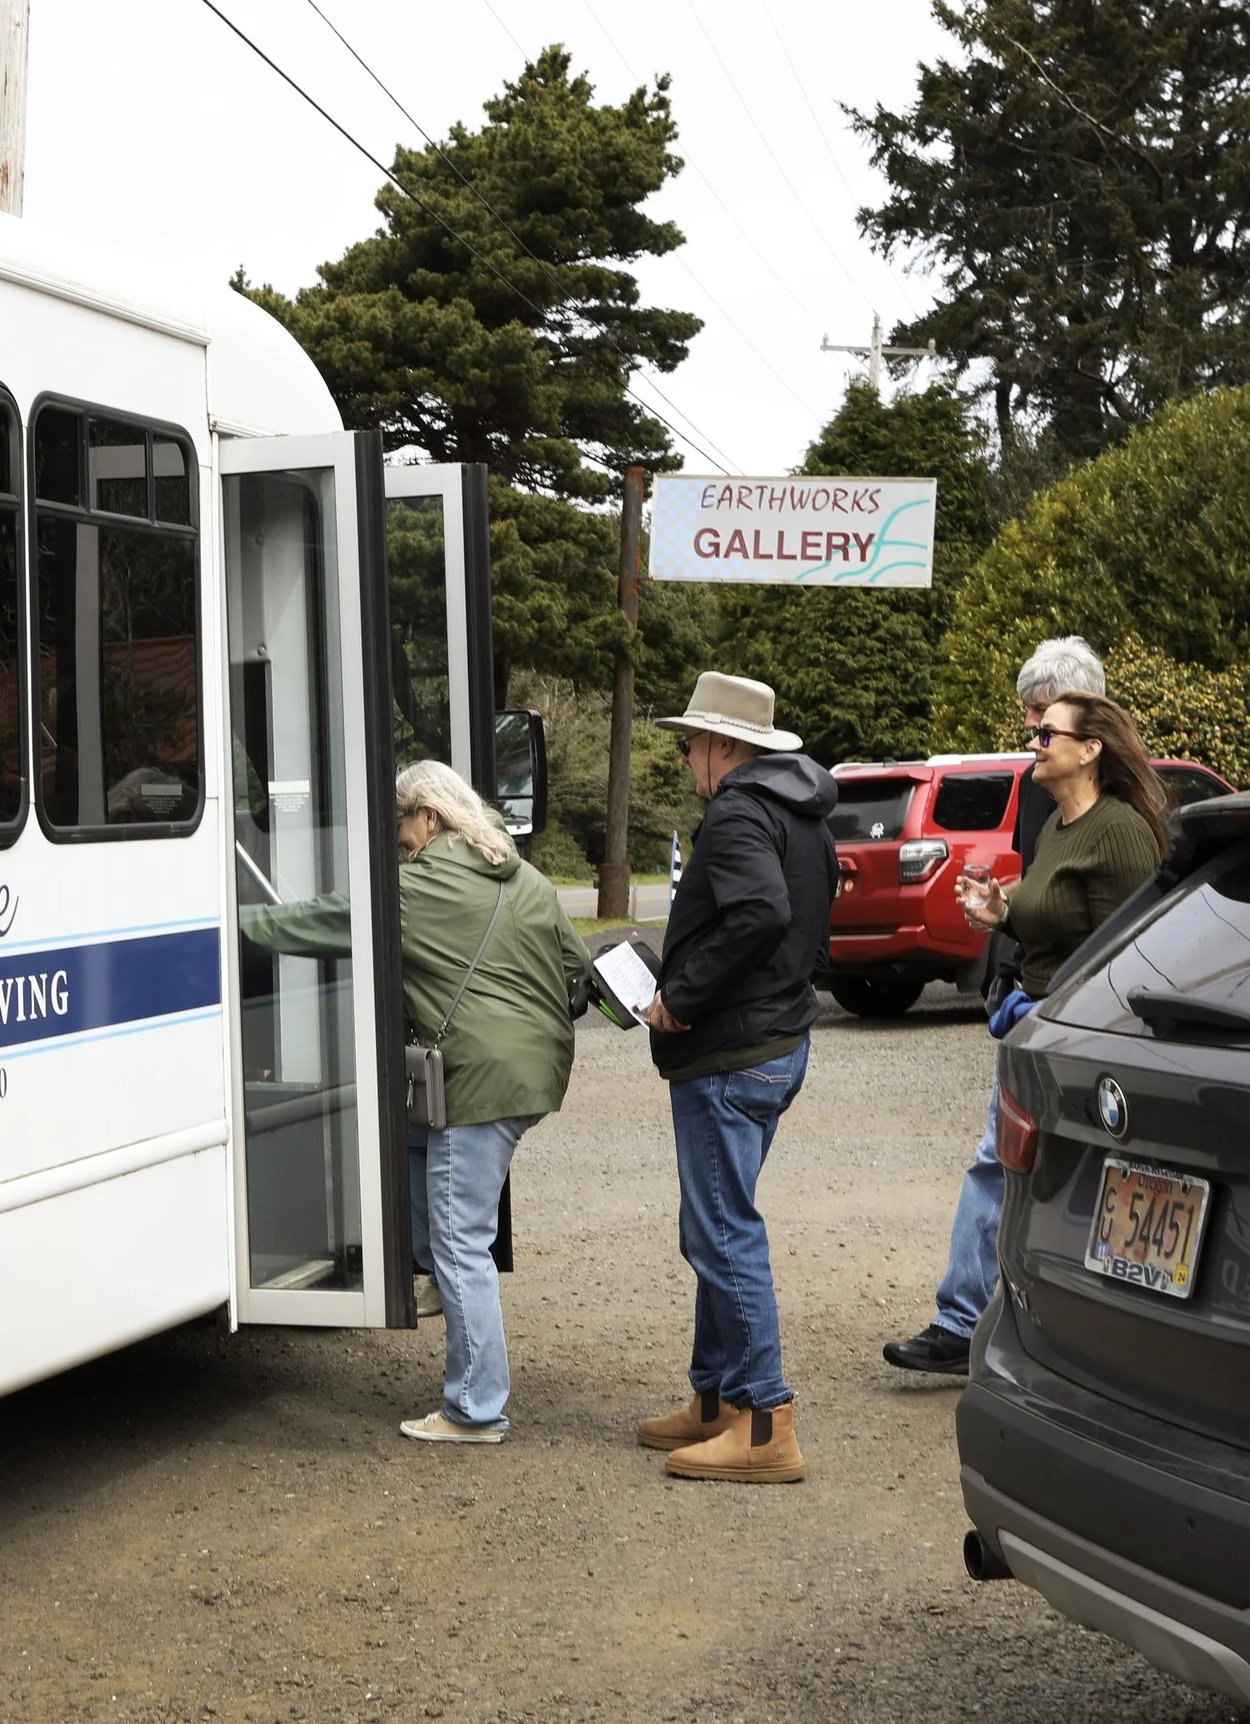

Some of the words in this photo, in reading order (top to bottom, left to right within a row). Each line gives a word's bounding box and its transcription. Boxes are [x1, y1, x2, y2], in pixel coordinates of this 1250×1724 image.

[701, 484, 881, 514] EARTHWORKS
[693, 528, 875, 562] GALLERY
[1124, 1192, 1195, 1264] 54451
